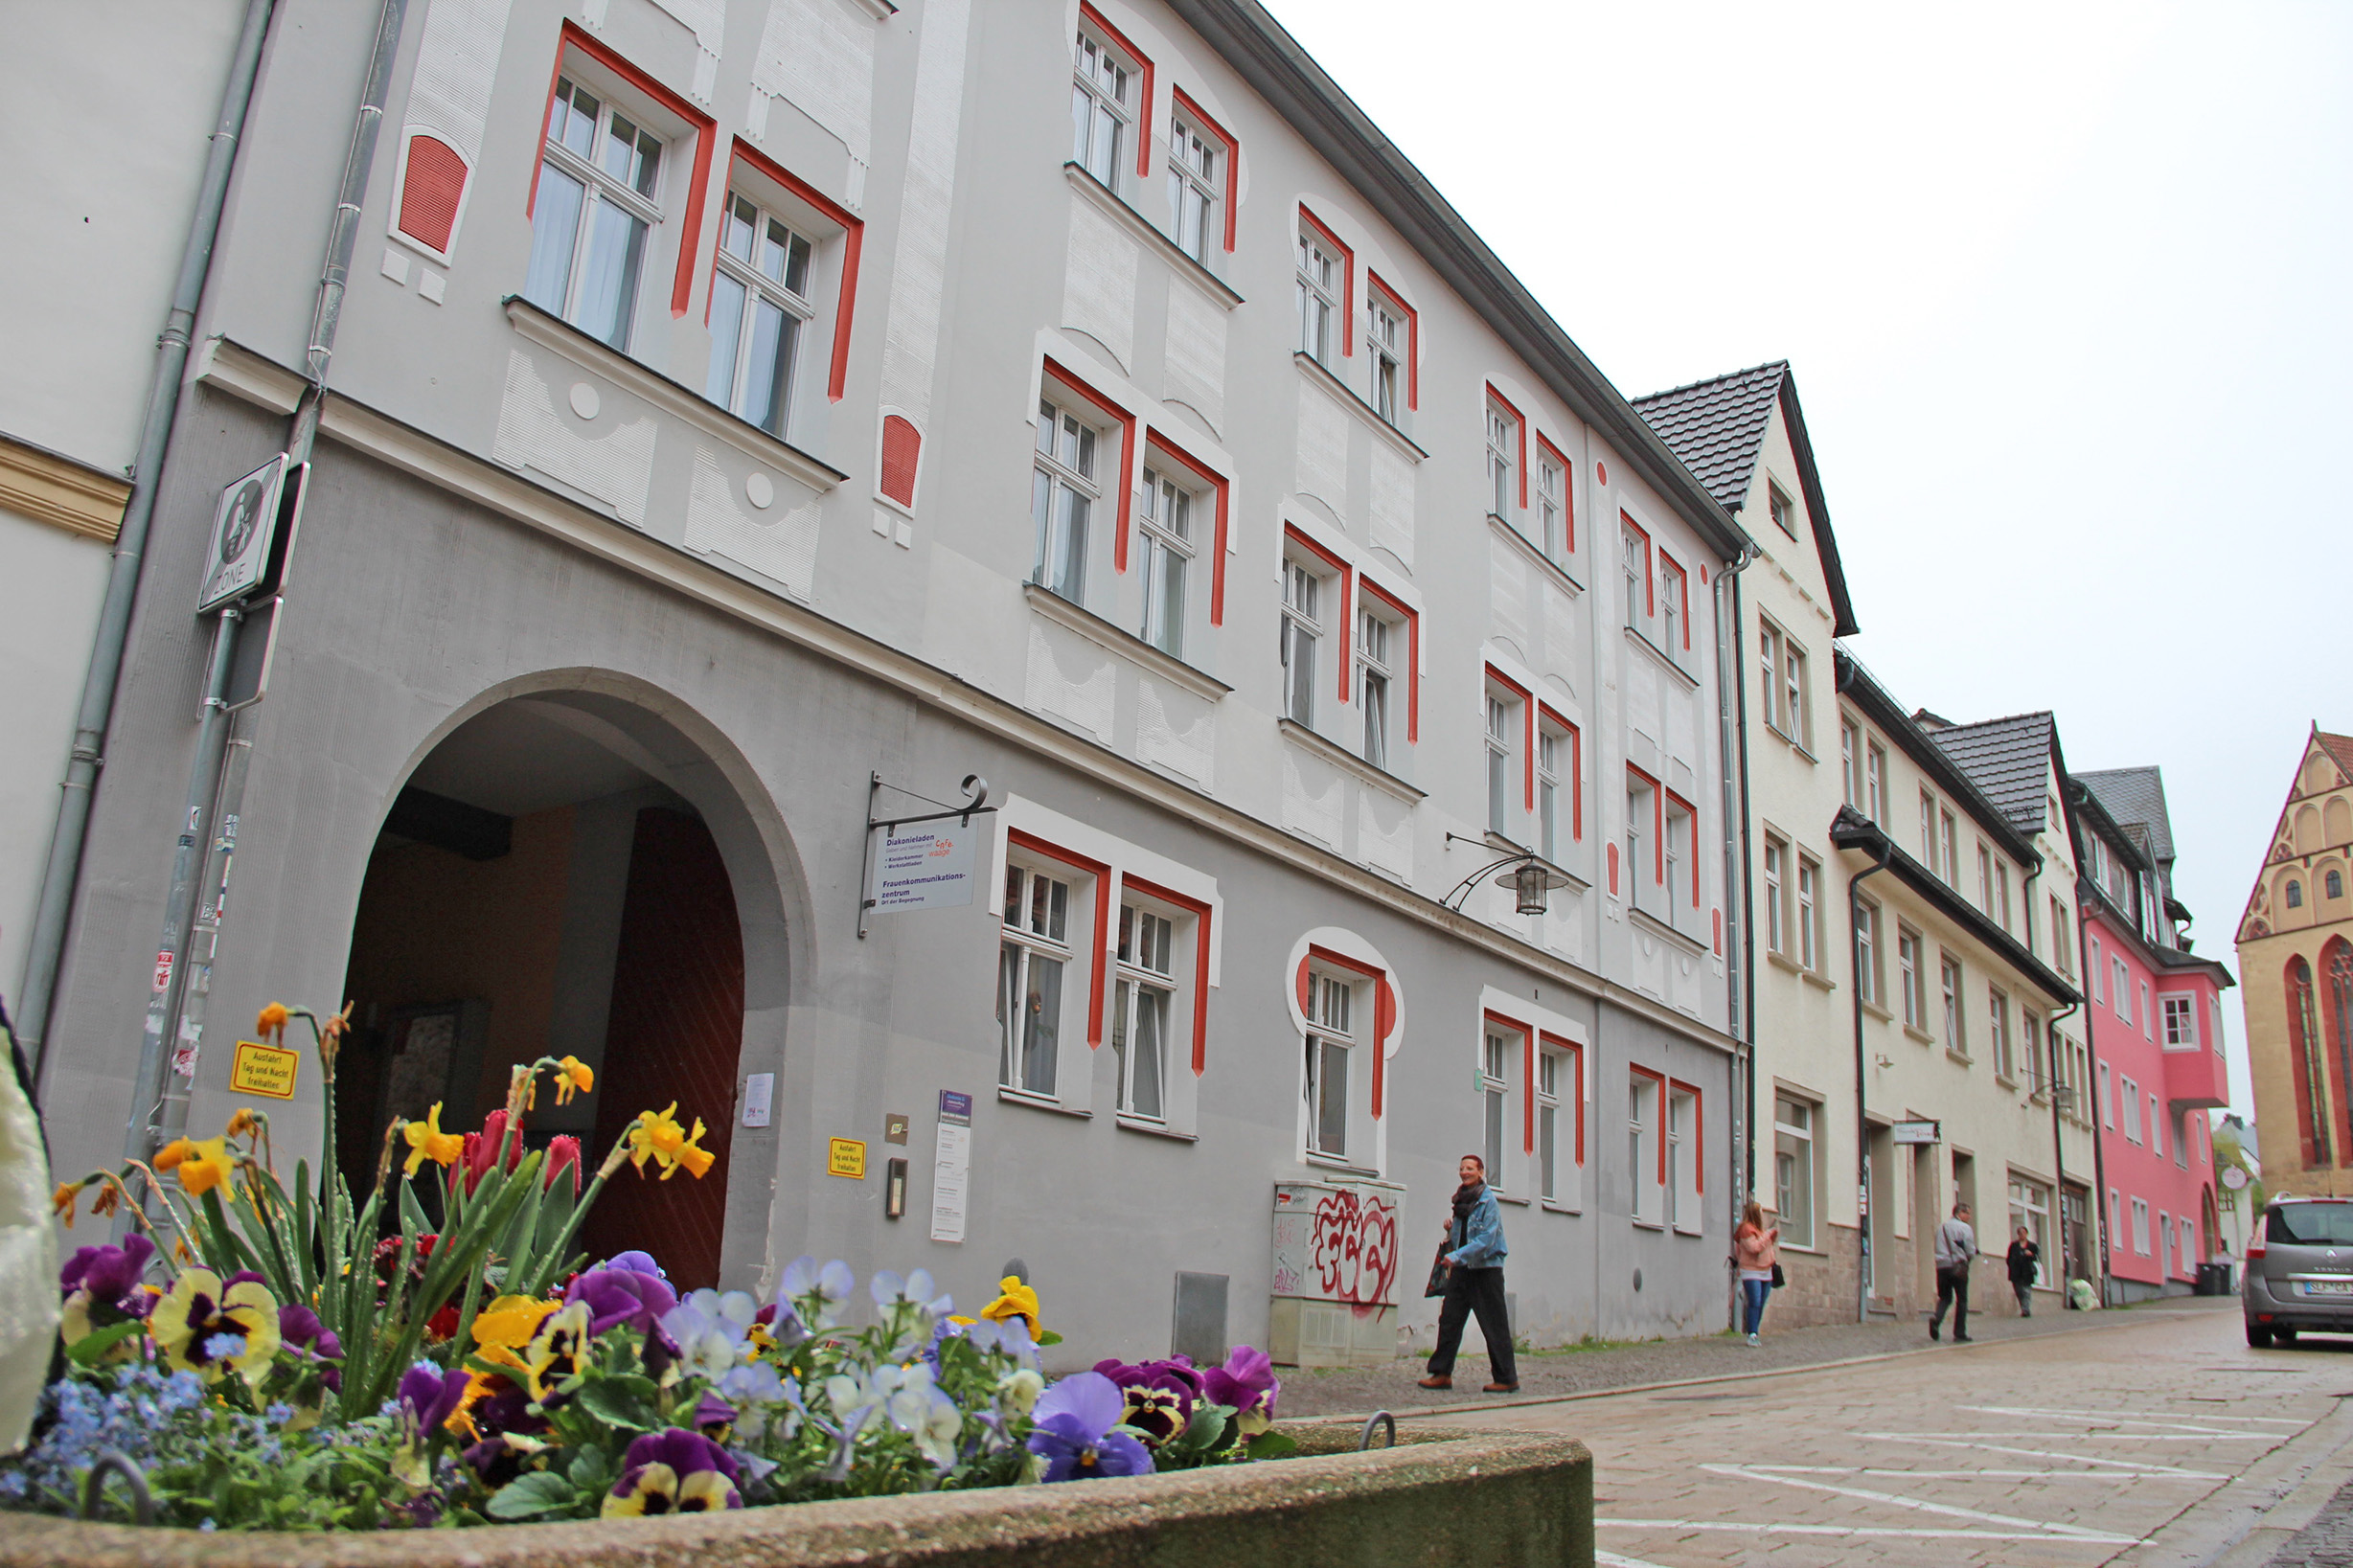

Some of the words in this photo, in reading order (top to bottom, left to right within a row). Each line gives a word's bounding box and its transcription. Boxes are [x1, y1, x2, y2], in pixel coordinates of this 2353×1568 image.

[214, 563, 246, 595] ZONE
[887, 835, 934, 846] Diakonieladen
[883, 874, 966, 887] Frauenkommunikations-
[881, 890, 910, 898] zentrum
[253, 1052, 282, 1063] Ausfahrt
[243, 1061, 255, 1074] Tag
[256, 1065, 269, 1075] und
[269, 1067, 289, 1078] Nacht
